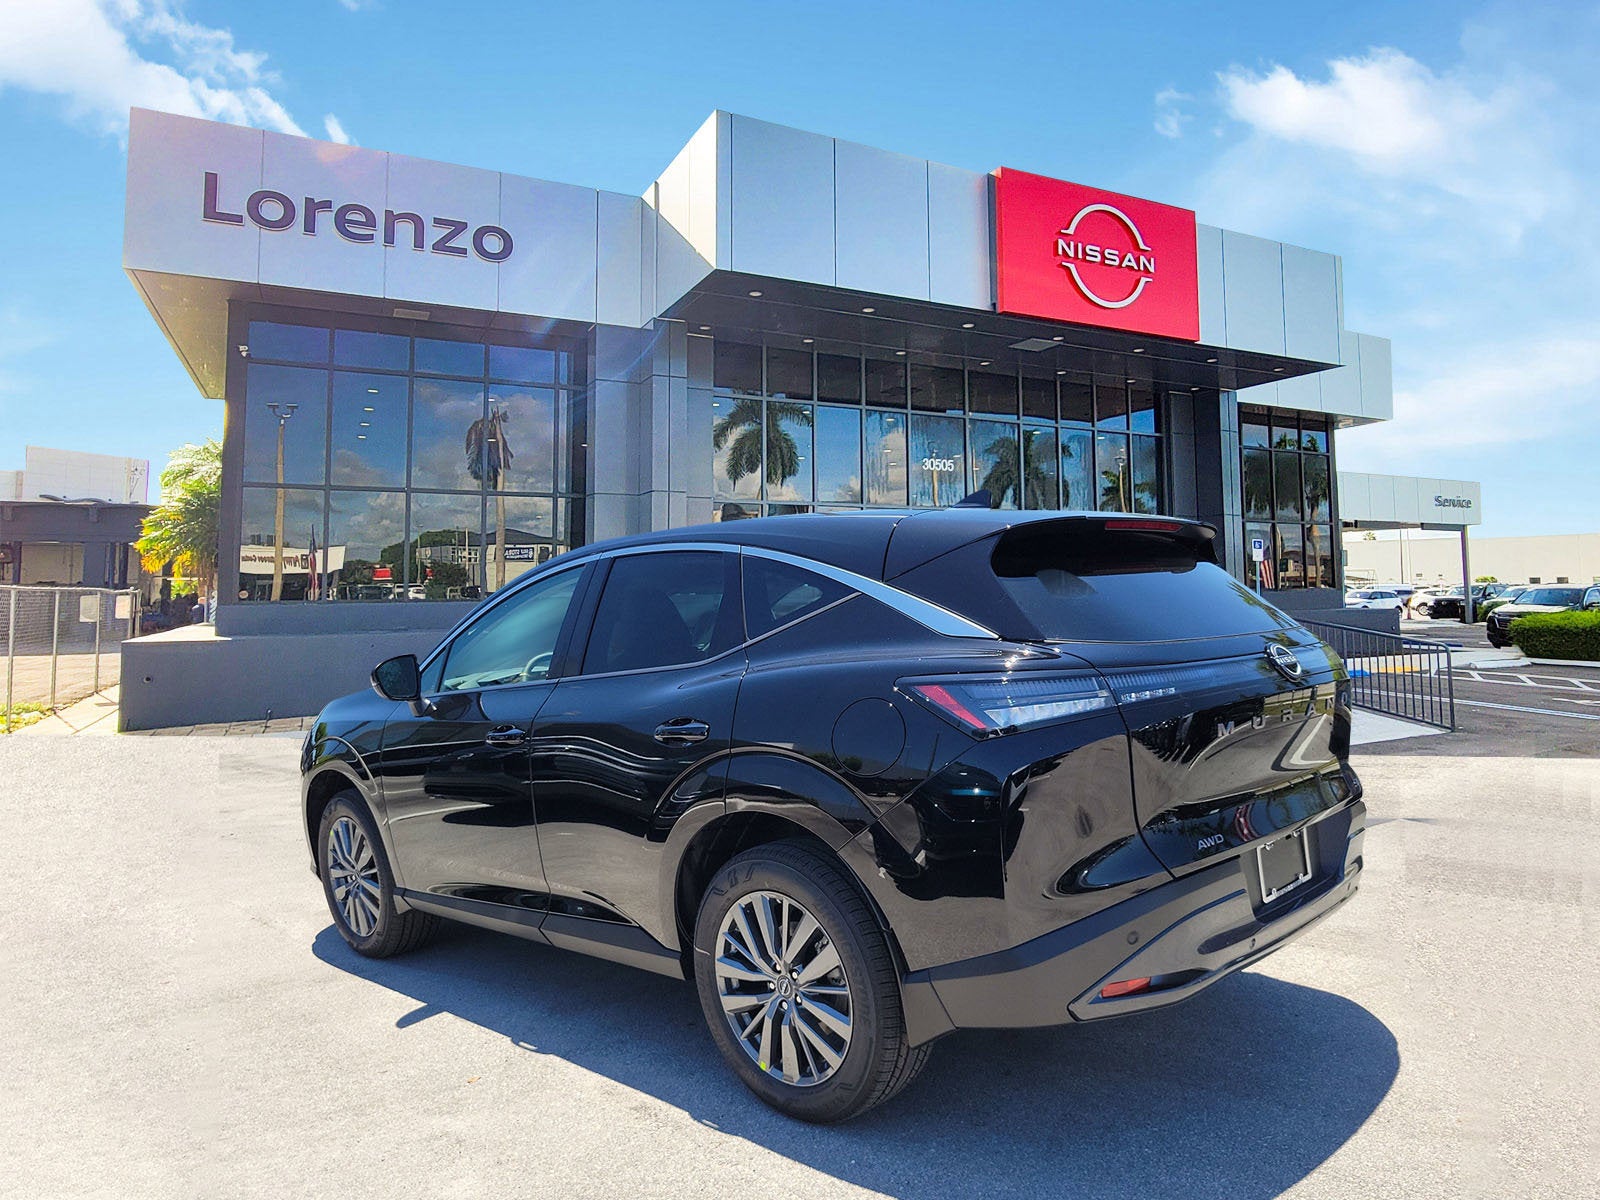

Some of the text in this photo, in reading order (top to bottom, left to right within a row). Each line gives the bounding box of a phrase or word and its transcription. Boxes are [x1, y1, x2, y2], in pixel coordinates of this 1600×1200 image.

[202, 171, 514, 262] Lorenzo
[1057, 238, 1154, 273] NISSAN
[922, 457, 955, 471] 30505
[1434, 495, 1472, 508] Service
[1275, 655, 1297, 666] NISSA
[1217, 692, 1348, 738] MURANO
[1198, 834, 1224, 850] AWD
